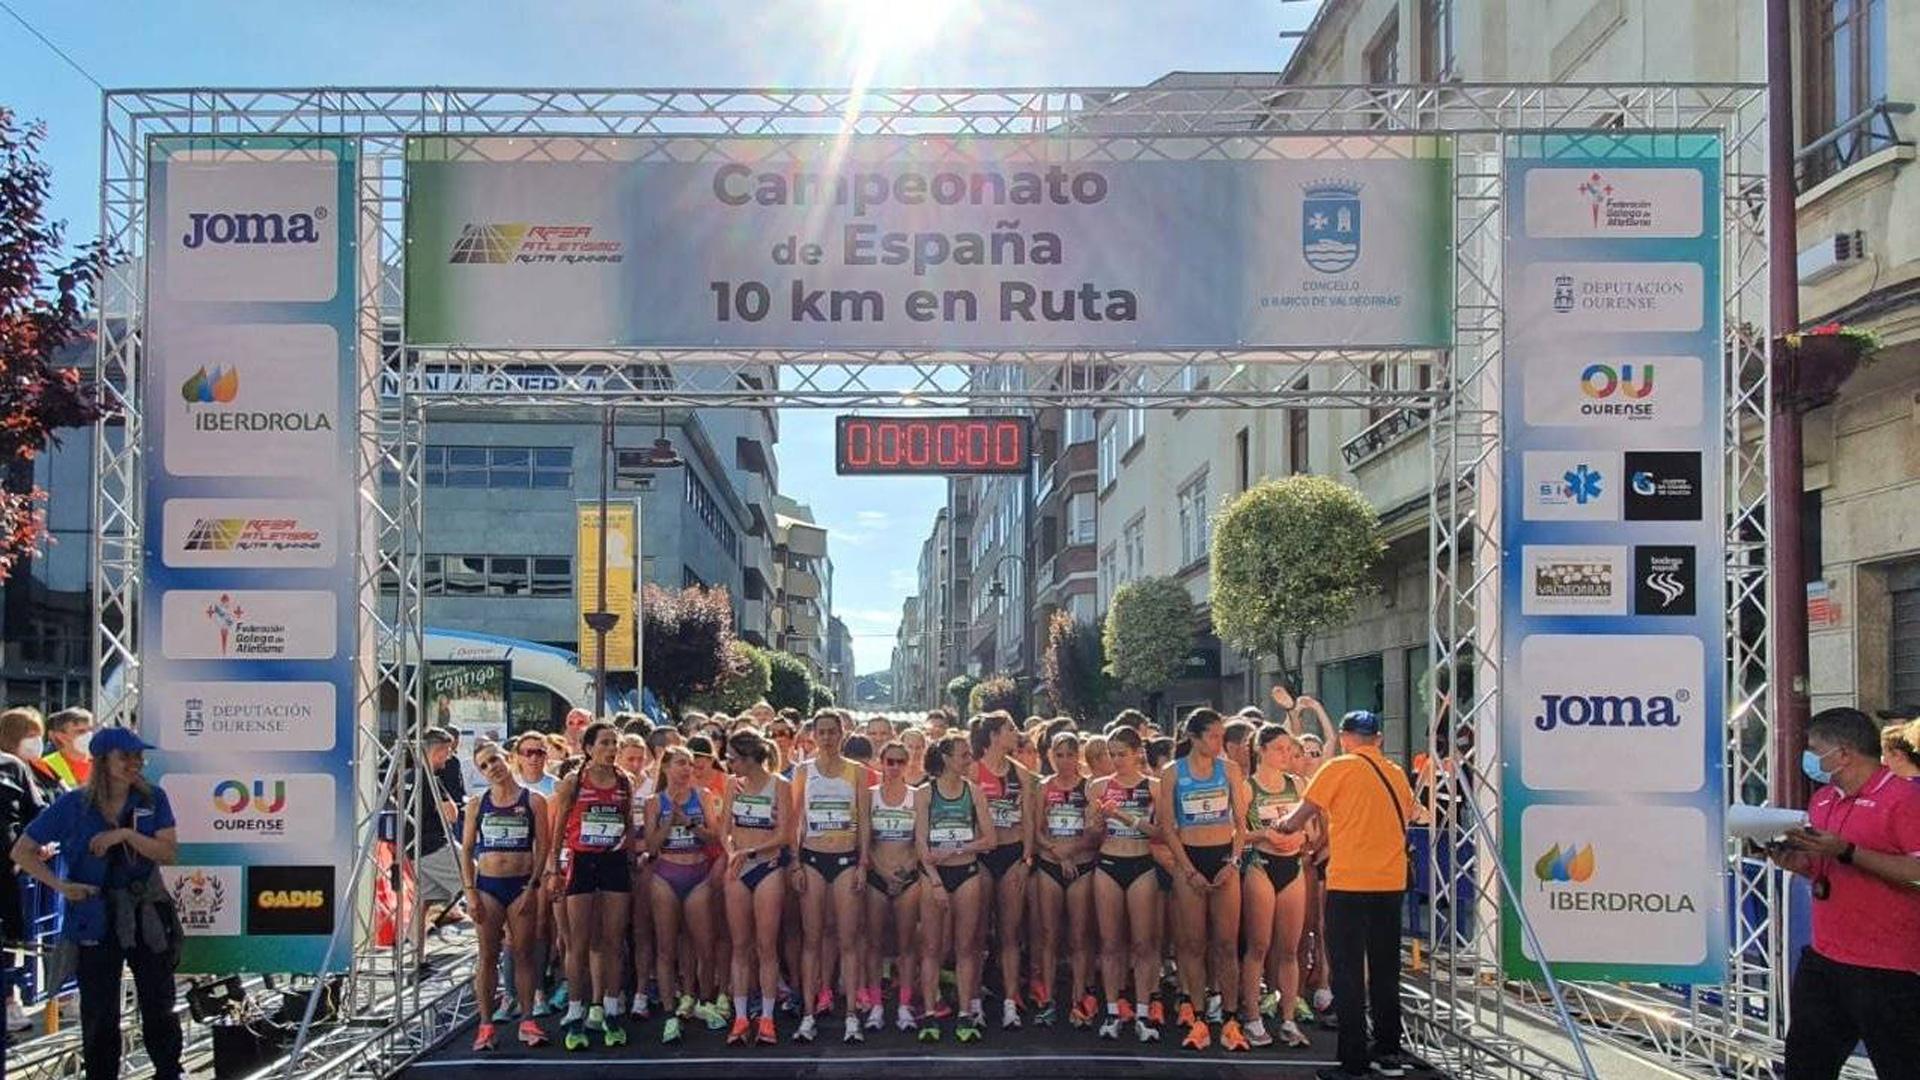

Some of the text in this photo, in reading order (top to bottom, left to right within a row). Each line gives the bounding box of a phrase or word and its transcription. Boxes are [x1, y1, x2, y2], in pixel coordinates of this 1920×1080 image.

[712, 163, 1108, 216] Campeonato
[772, 219, 1063, 275] de España
[1302, 281, 1360, 291] CONCELLO
[1583, 281, 1684, 294] DEPUTACIÓN
[710, 280, 1138, 322] 10 km en Ruta
[1582, 298, 1657, 309] OURENSE
[1581, 364, 1654, 399] OU
[195, 412, 332, 431] IBERDROLA
[849, 424, 1019, 465] 00:00:00
[213, 703, 311, 716] DEPUTACIÓN
[212, 720, 285, 732] OURENSE
[213, 780, 286, 813] OU
[600, 823, 607, 834] 7
[885, 819, 900, 829] 17
[258, 889, 324, 908] GADIS
[1550, 892, 1696, 912] IBERDROLA
